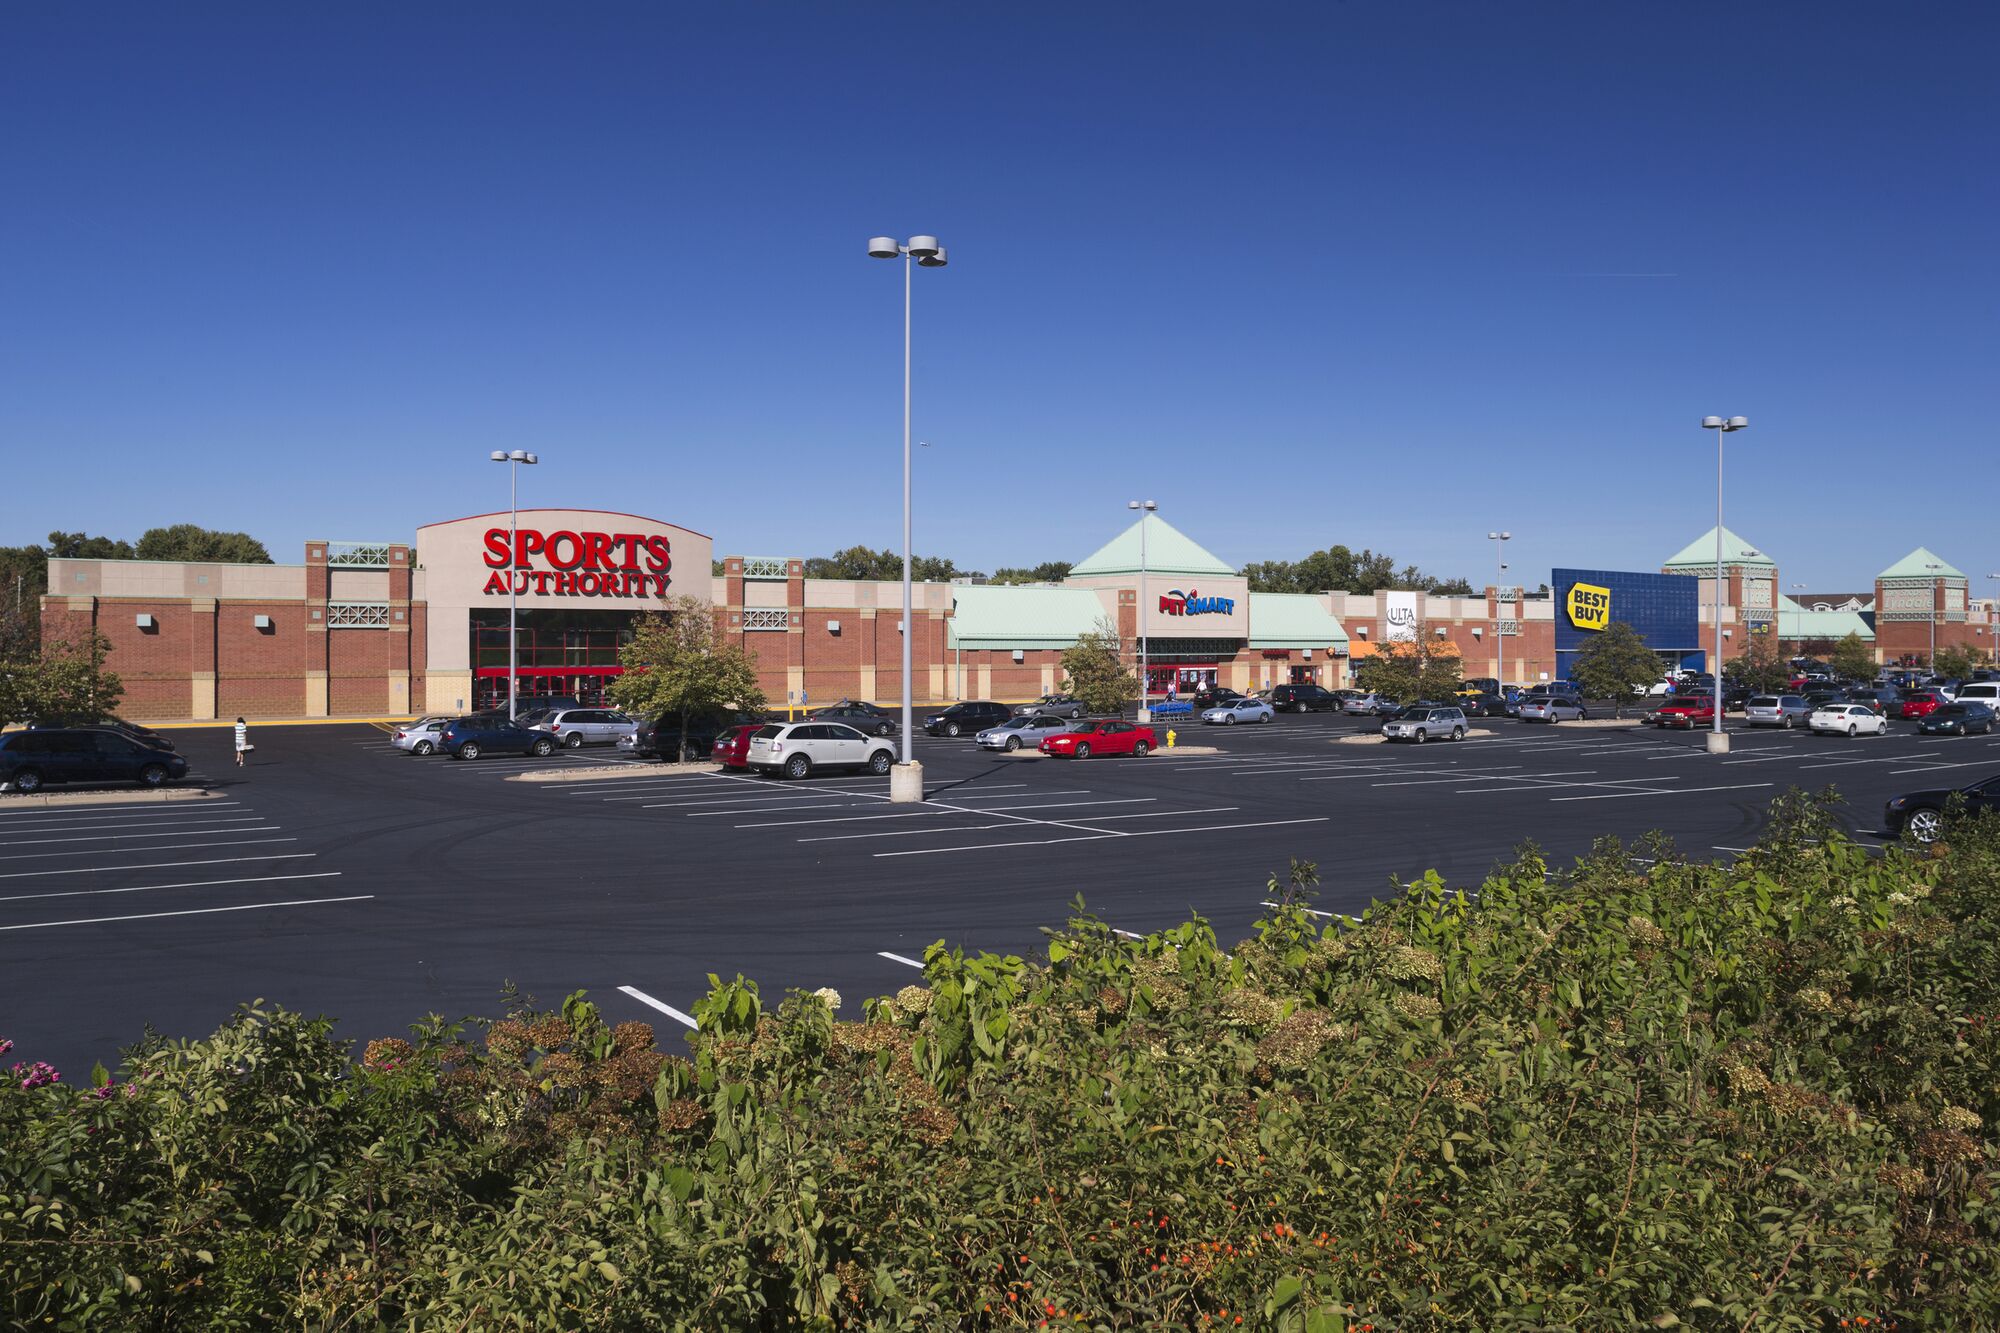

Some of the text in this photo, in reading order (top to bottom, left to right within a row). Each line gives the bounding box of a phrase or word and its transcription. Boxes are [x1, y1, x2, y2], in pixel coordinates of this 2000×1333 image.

[483, 528, 671, 574] SPORTS
[483, 570, 672, 598] AUTHORITY
[1574, 589, 1608, 608] BEST
[1391, 607, 1415, 621] ULTA
[1575, 605, 1604, 623] BUY
